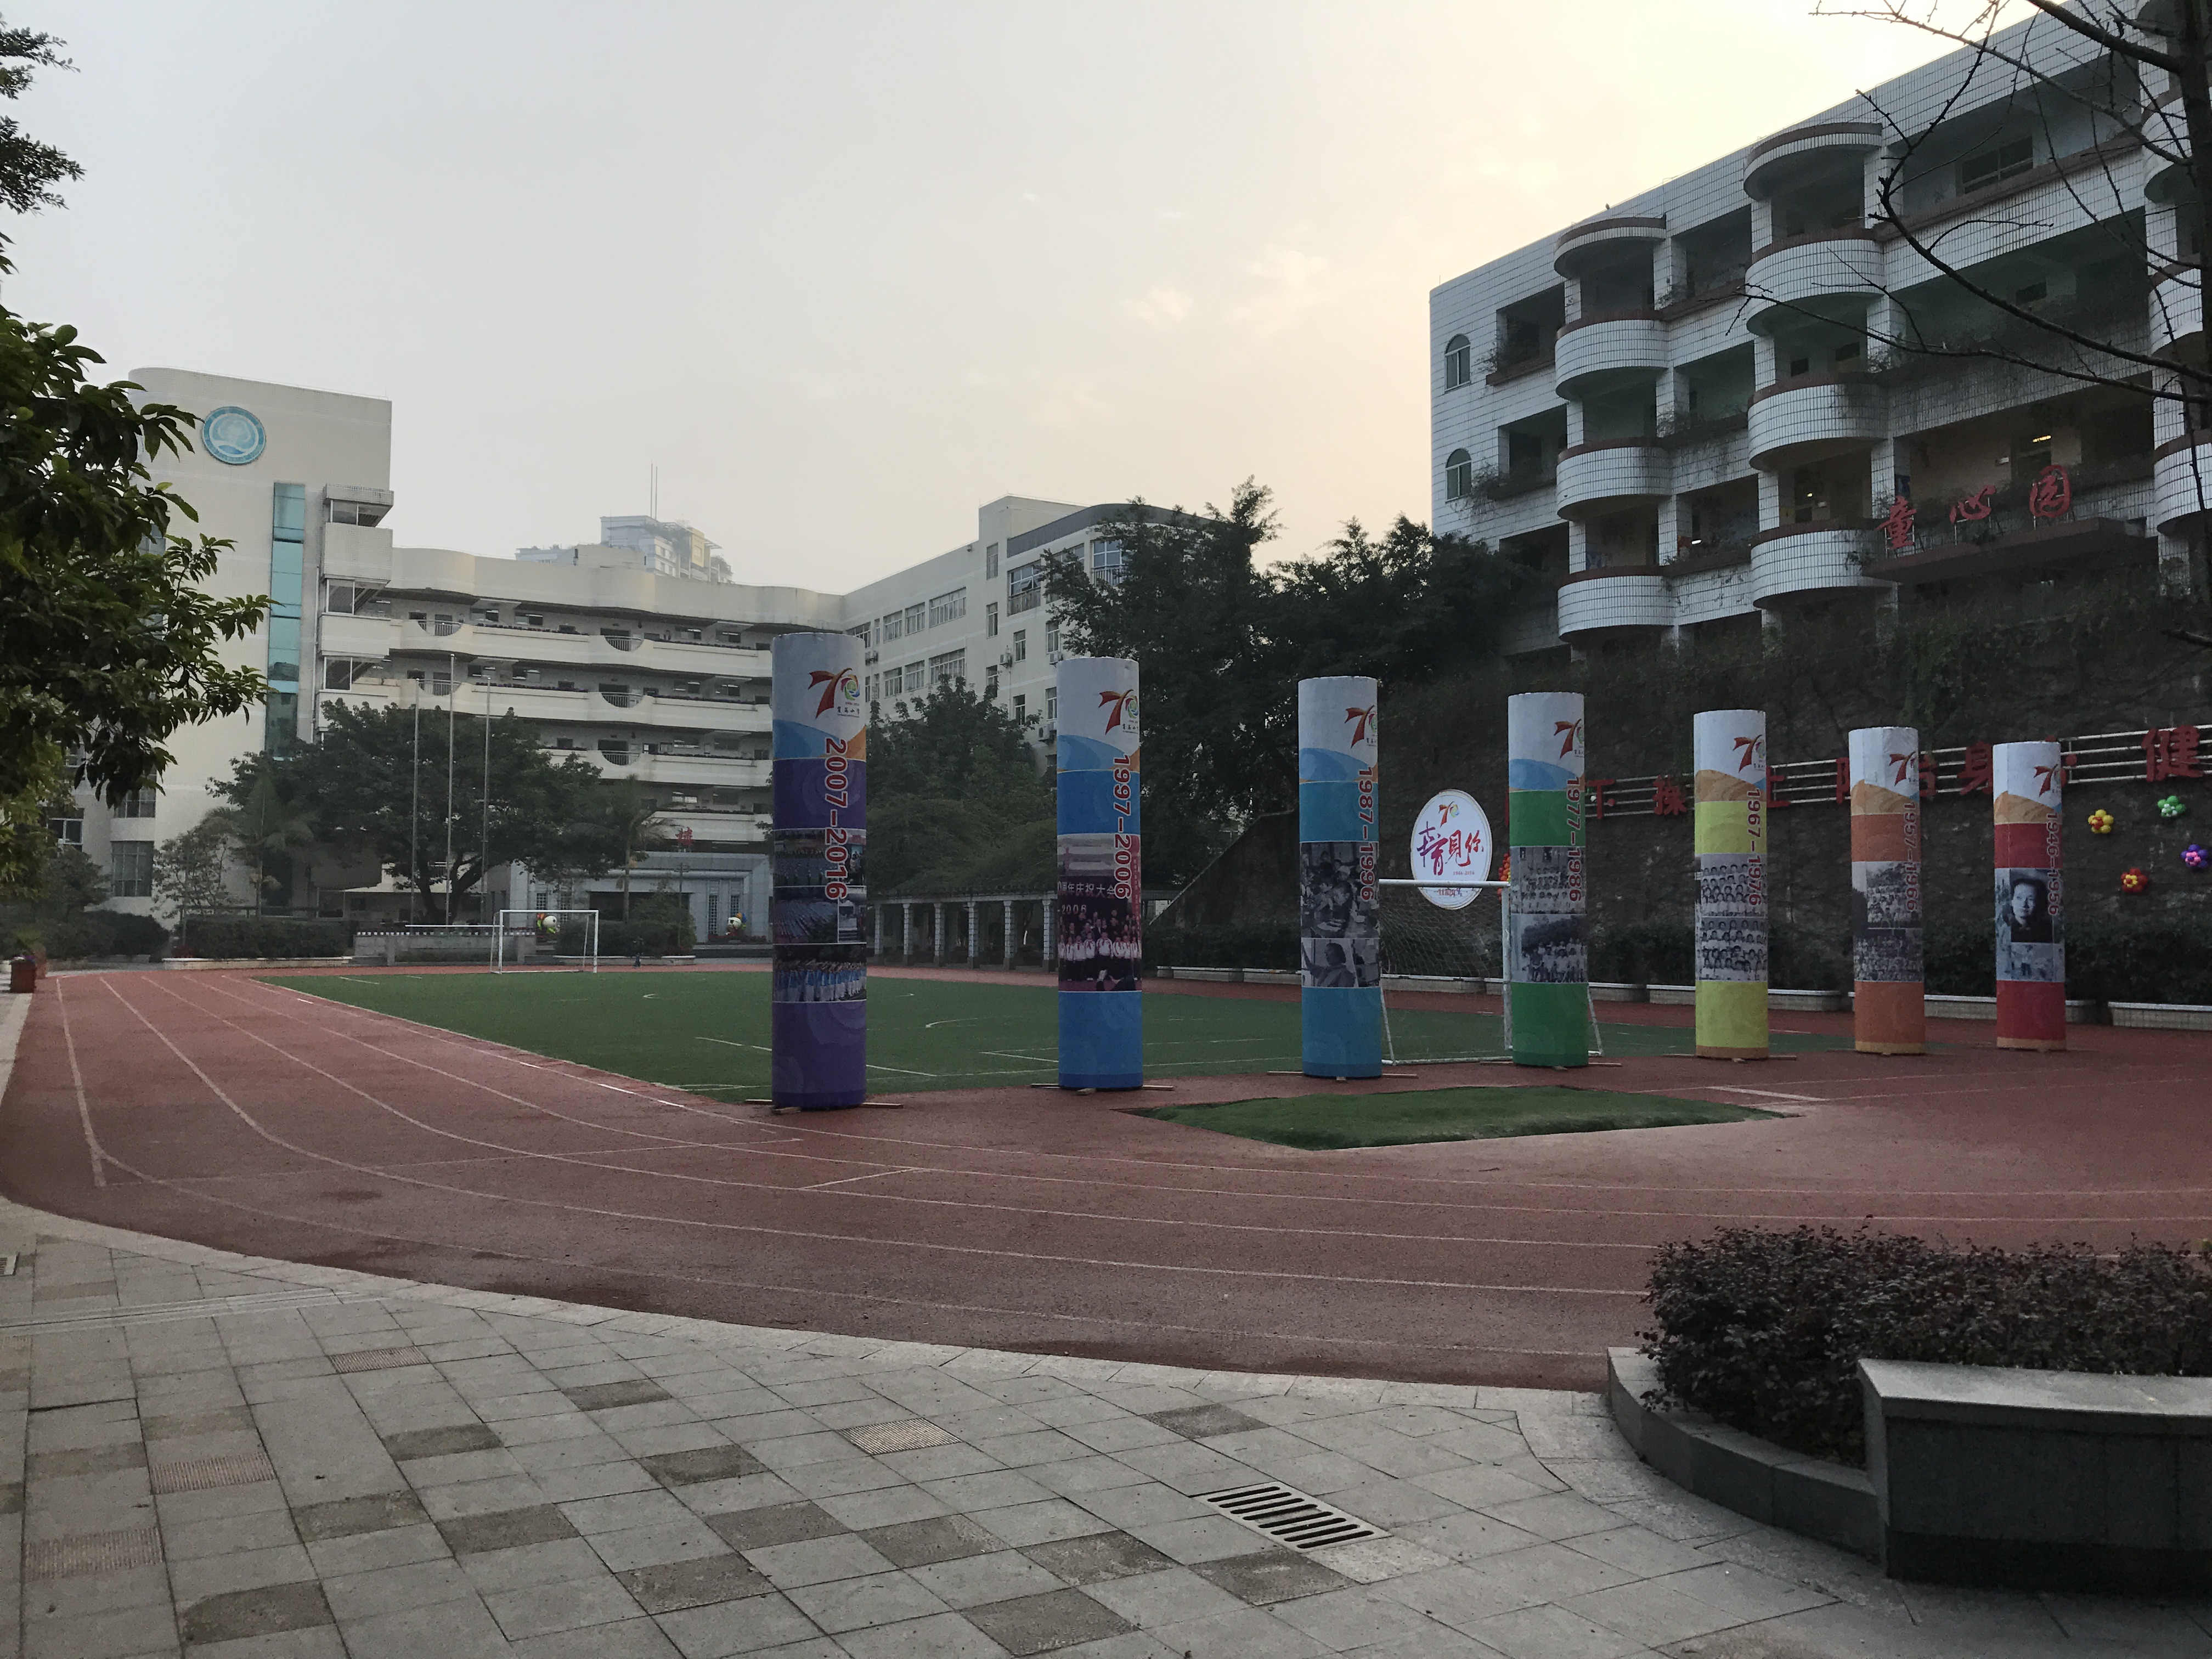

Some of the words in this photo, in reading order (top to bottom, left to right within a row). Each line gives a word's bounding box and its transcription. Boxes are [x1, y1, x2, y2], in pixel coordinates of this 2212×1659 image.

[824, 737, 848, 900] 2007-2016
[1113, 754, 1132, 900] 1997-2006
[1358, 766, 1375, 901] 1987-1996
[1567, 777, 1581, 902] 1977-1986
[1747, 788, 1762, 906] 1967-1976
[1904, 802, 1918, 911] 1957-1966
[2046, 812, 2061, 916] 1946-1956
